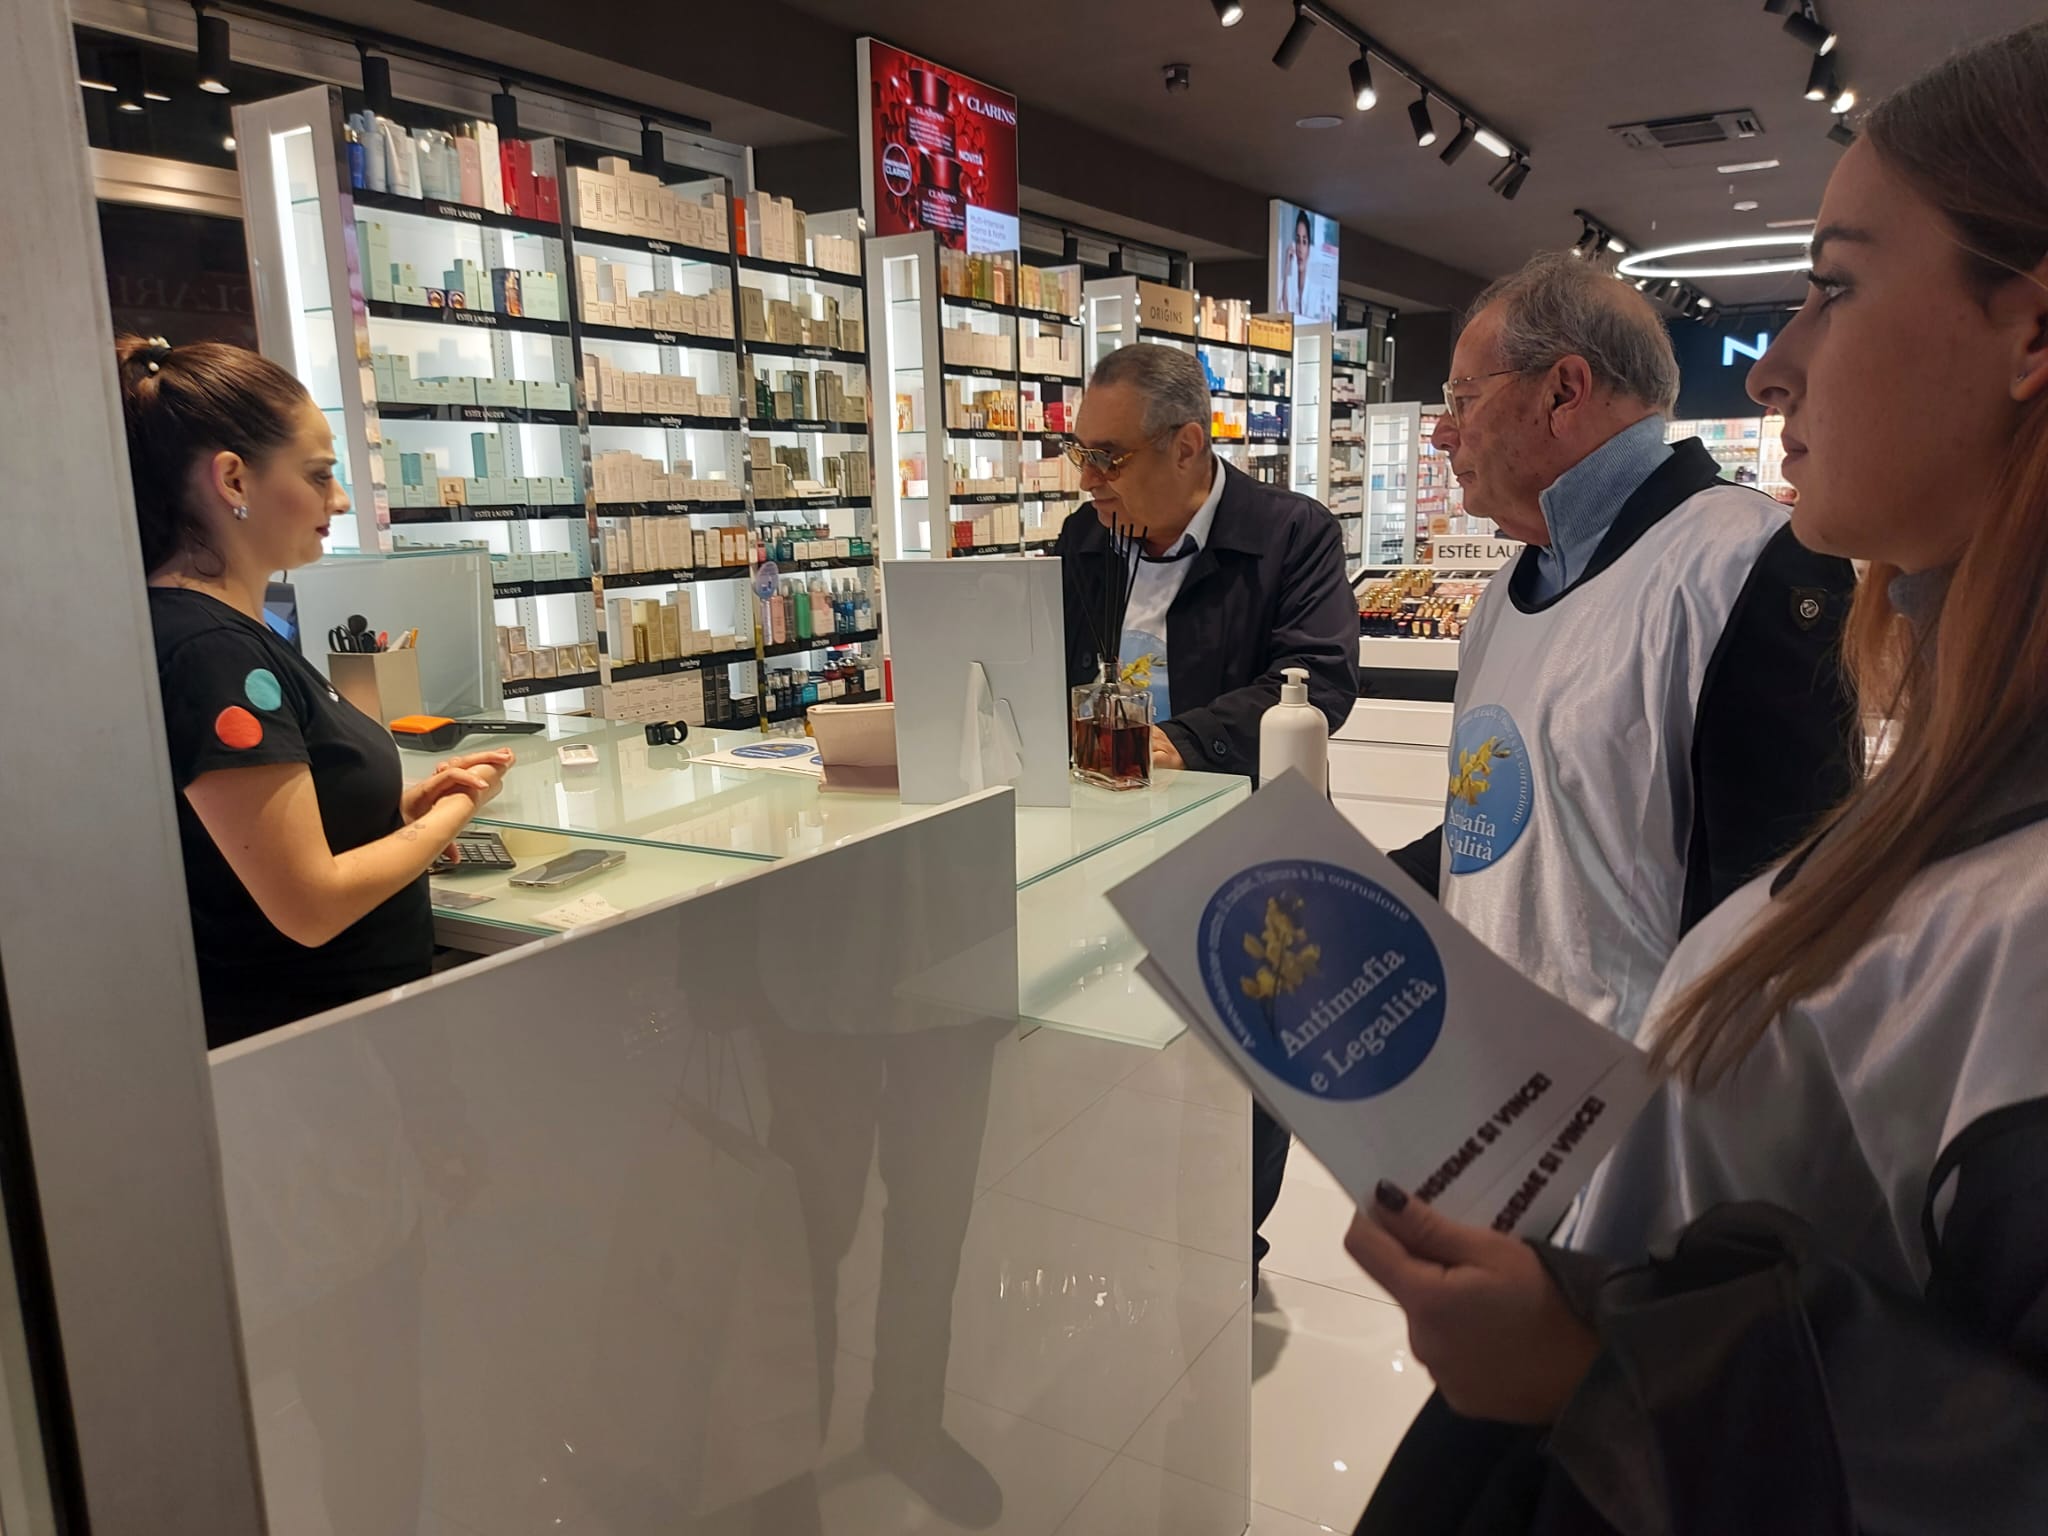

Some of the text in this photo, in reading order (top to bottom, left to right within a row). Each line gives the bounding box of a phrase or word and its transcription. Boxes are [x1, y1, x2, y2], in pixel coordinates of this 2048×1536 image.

[967, 97, 1016, 125] CLARINS
[1150, 306, 1183, 325] ORIGINS
[1486, 544, 1525, 559] LAU
[1280, 949, 1405, 1060] Antimafia
[1310, 978, 1438, 1092] e Legalità
